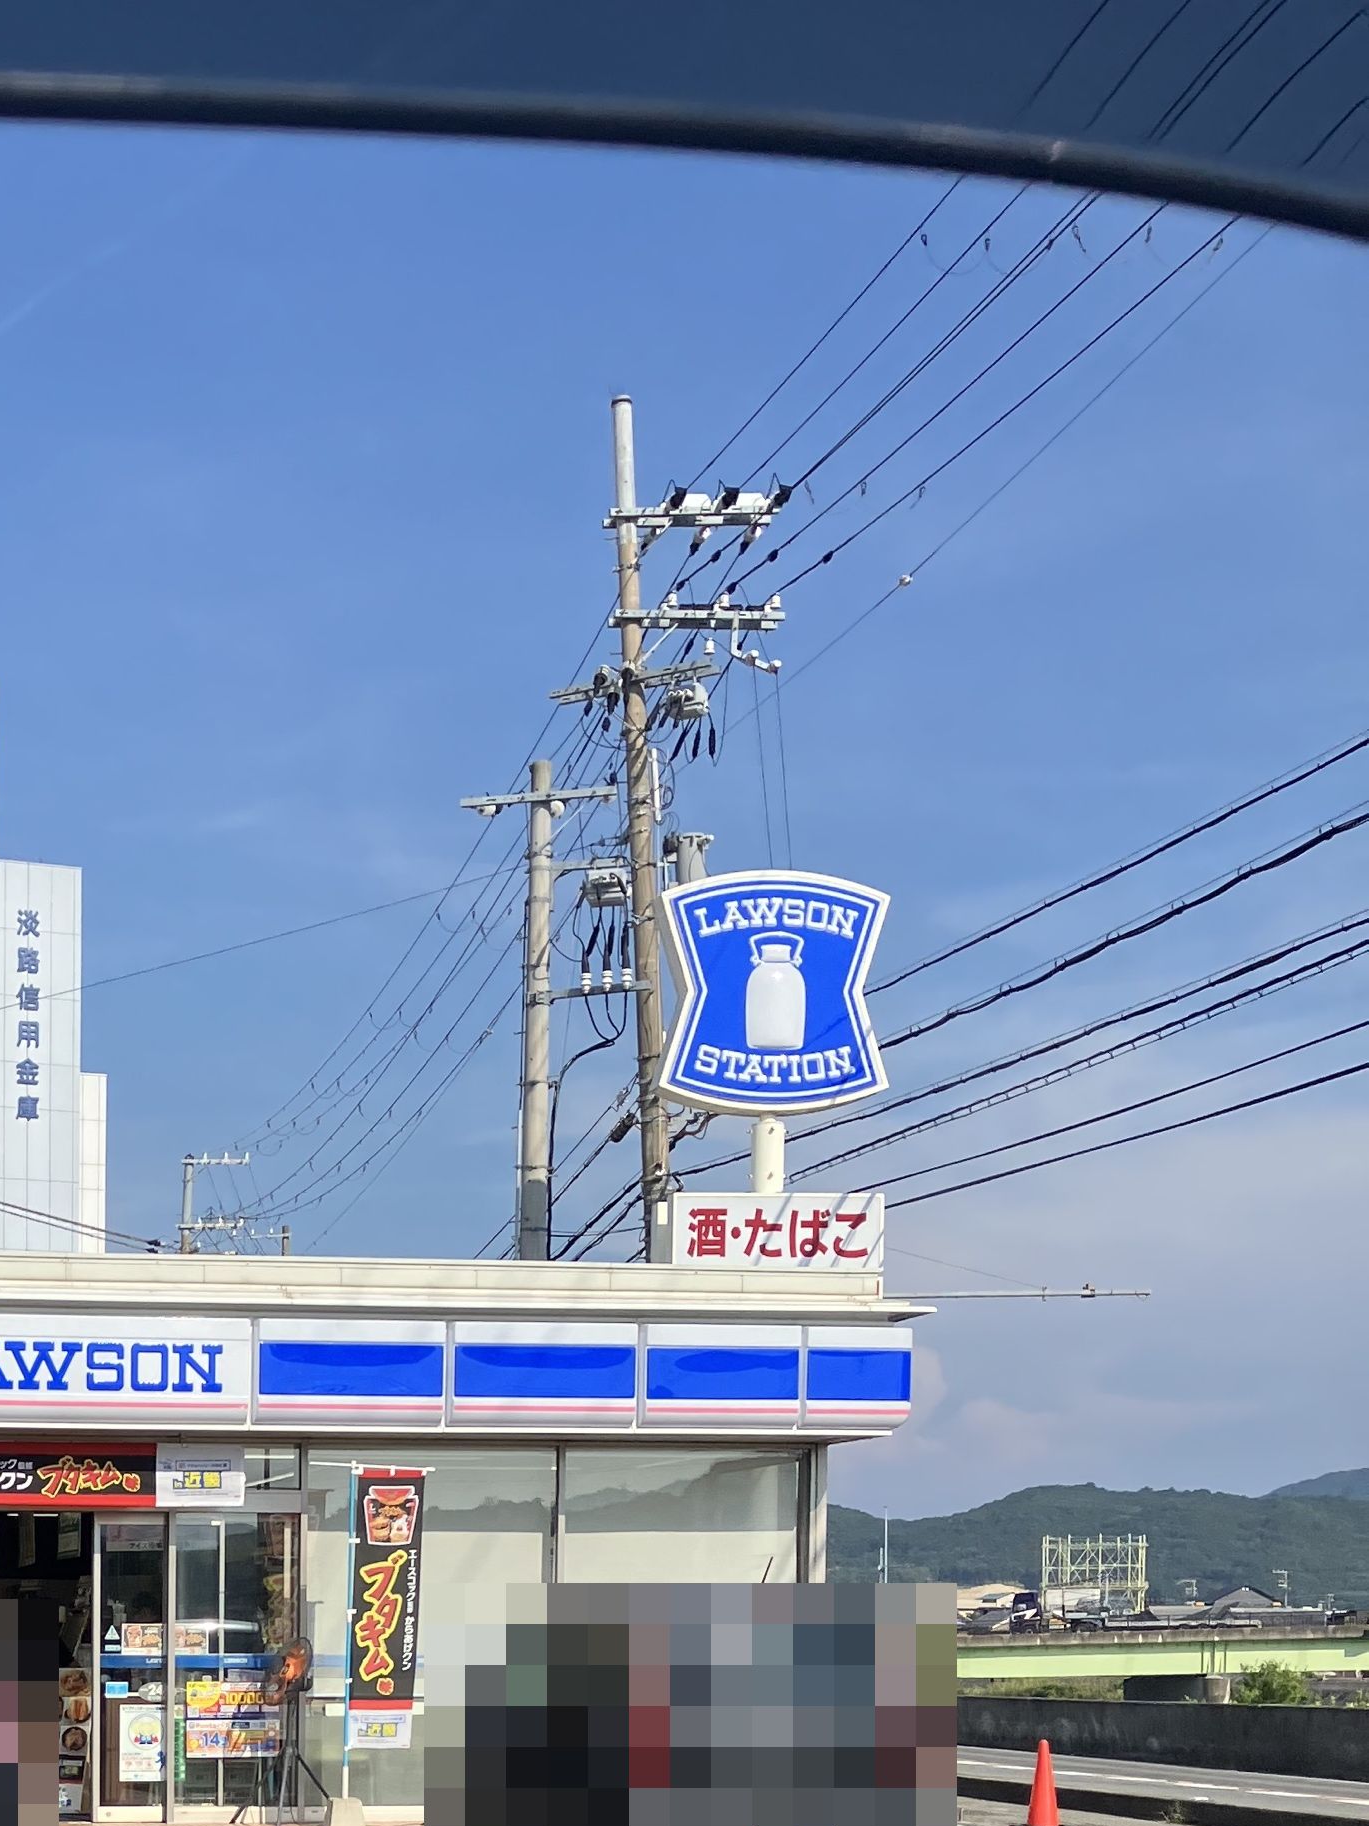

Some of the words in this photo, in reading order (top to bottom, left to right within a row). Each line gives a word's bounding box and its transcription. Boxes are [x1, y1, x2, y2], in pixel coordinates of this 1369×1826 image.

[693, 897, 859, 940] LAWSON
[16, 909, 41, 1121] 淡路信用金庫
[694, 1044, 856, 1084] STATION
[686, 1207, 869, 1259] 酒・たばこ
